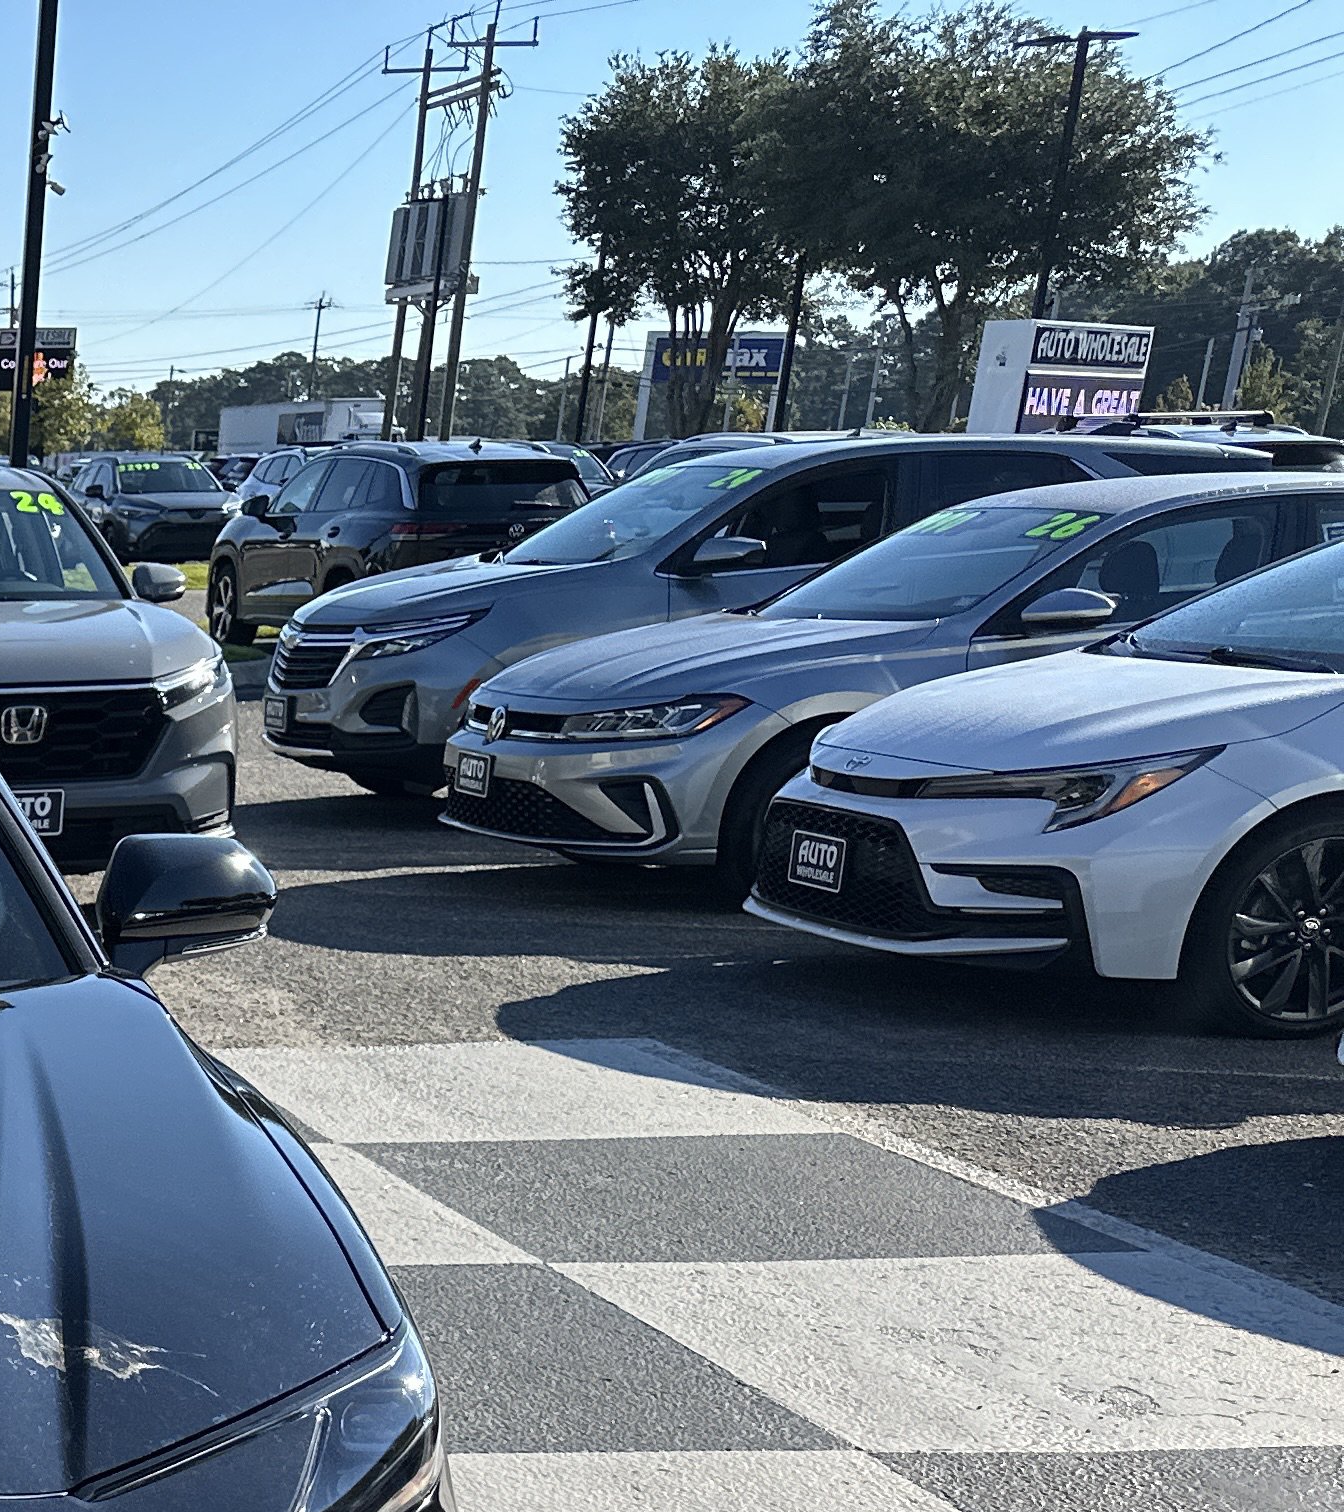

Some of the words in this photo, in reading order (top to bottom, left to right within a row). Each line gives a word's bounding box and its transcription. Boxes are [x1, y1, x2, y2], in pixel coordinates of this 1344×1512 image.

[1037, 330, 1075, 359] AUTO
[1077, 331, 1149, 363] WHOLESALE
[1024, 387, 1071, 415] HAVE
[1073, 389, 1085, 414] A
[1092, 389, 1141, 415] GREAT
[1024, 512, 1101, 541] 26
[459, 757, 485, 779] AUTO
[798, 840, 838, 868] AUTO
